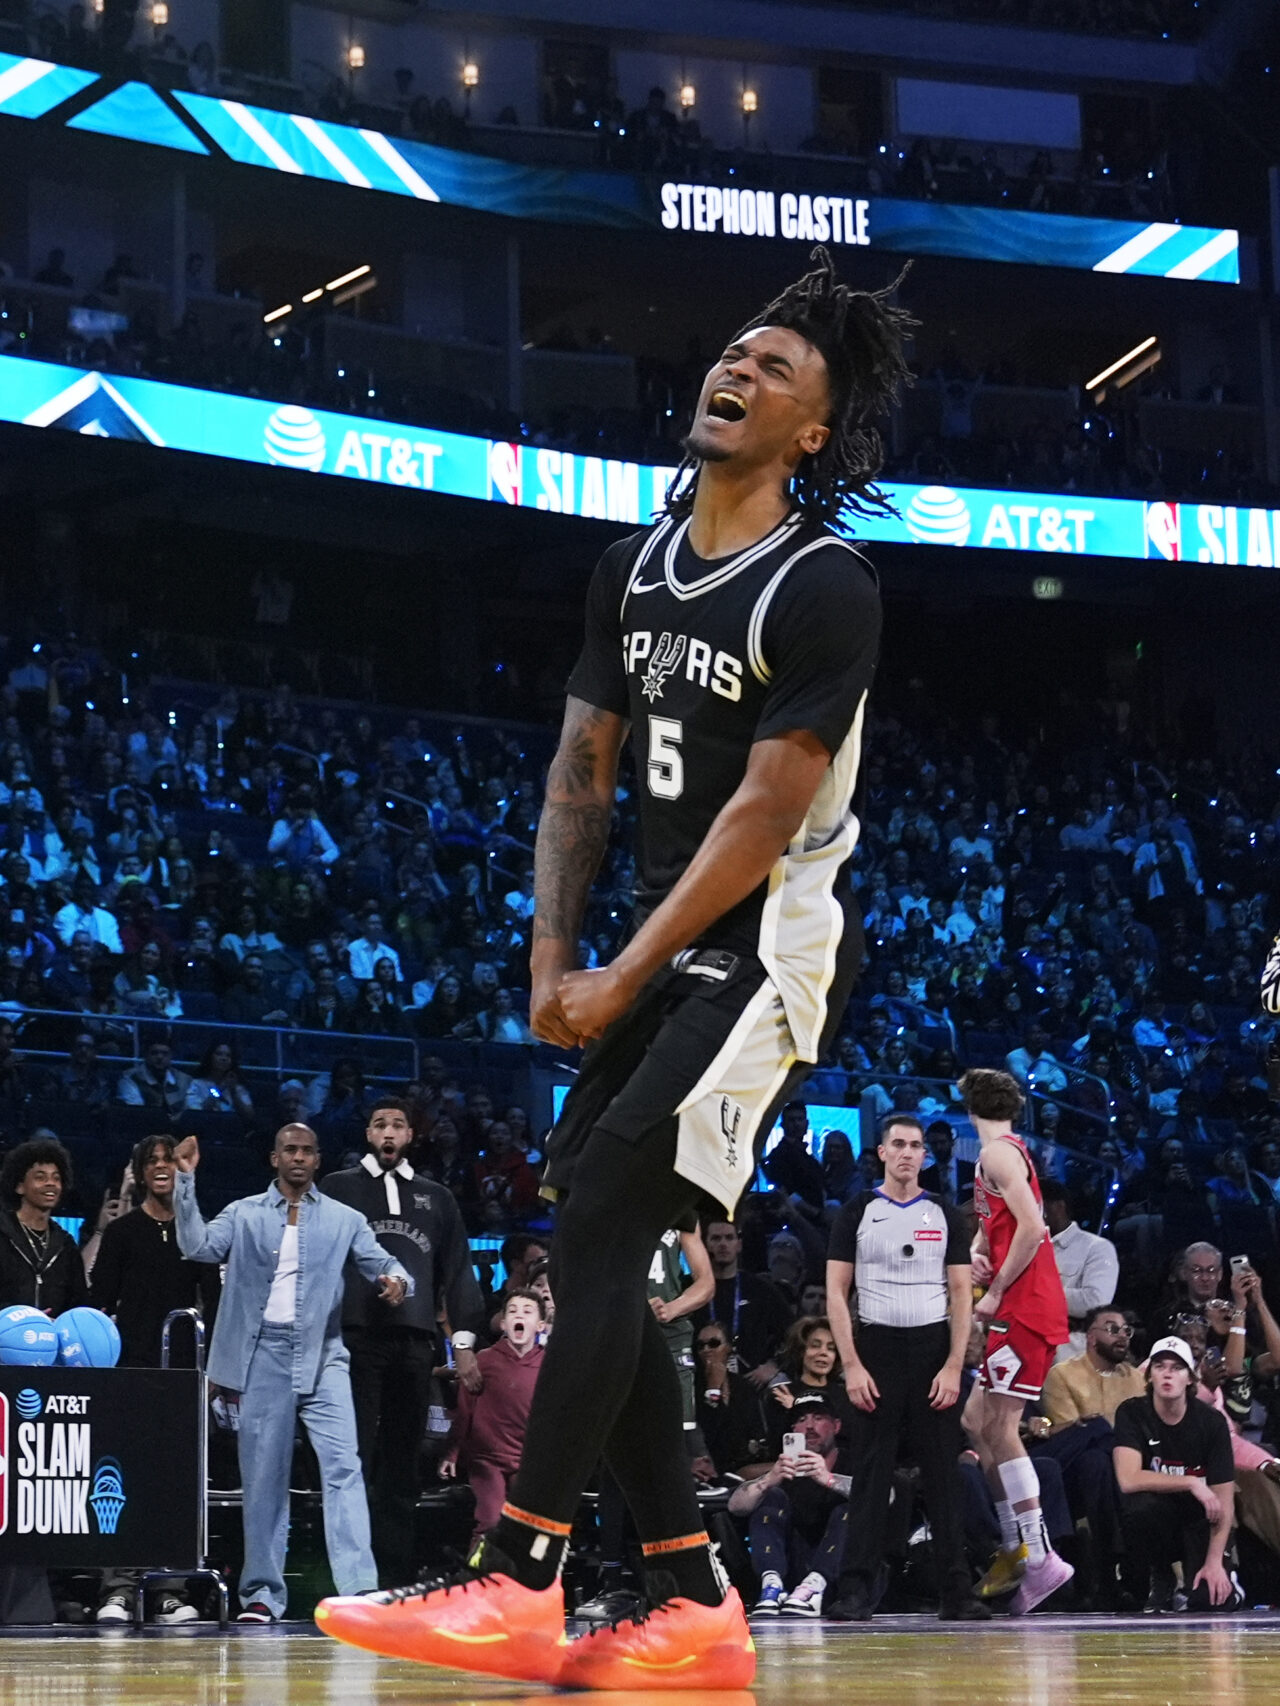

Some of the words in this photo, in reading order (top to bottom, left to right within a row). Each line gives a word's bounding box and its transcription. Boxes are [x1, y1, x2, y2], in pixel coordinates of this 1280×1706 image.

[661, 182, 775, 237] STEPHON
[780, 193, 870, 245] CASTLE
[333, 431, 443, 489] AT&T
[536, 448, 639, 524] SLAM
[982, 504, 1095, 552] AT&T
[1197, 504, 1280, 568] SLA
[647, 714, 684, 801] 5
[44, 1395, 91, 1414] AT&T
[17, 1421, 91, 1478] SLAM
[17, 1479, 91, 1534] DUNK
